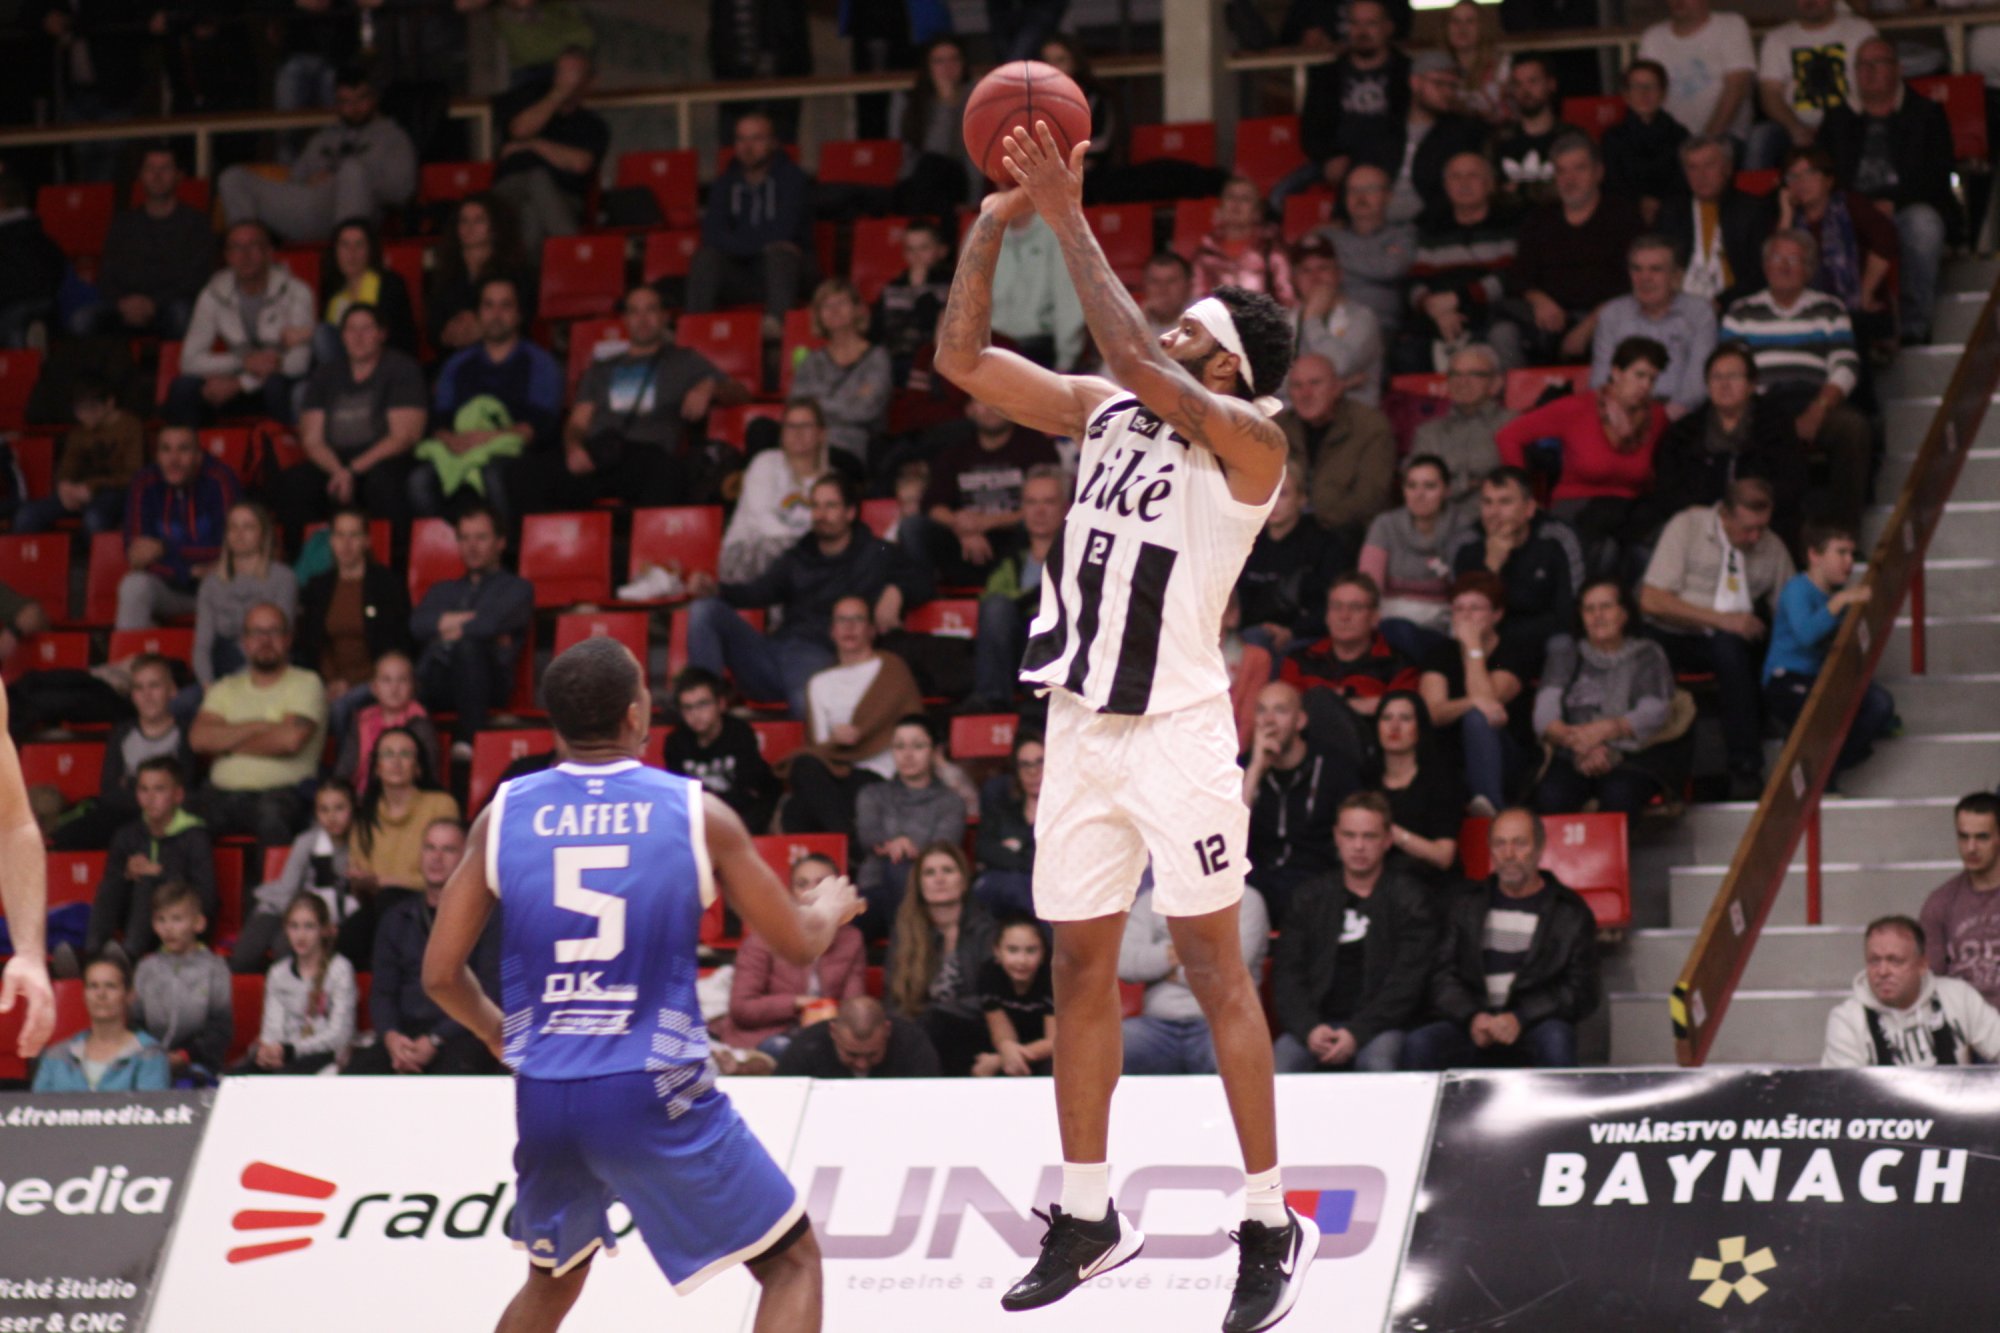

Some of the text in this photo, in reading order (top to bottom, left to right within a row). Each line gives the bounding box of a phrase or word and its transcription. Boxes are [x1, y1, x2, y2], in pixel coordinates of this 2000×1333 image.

[533, 801, 653, 837] CAFFEY
[1193, 833, 1230, 877] 12
[553, 845, 630, 963] 5
[1589, 1113, 1935, 1144] VINÁRSTVO NAŠICH OTCOV
[1538, 1147, 1968, 1206] BAYNACH
[69, 1312, 127, 1332] CNC
